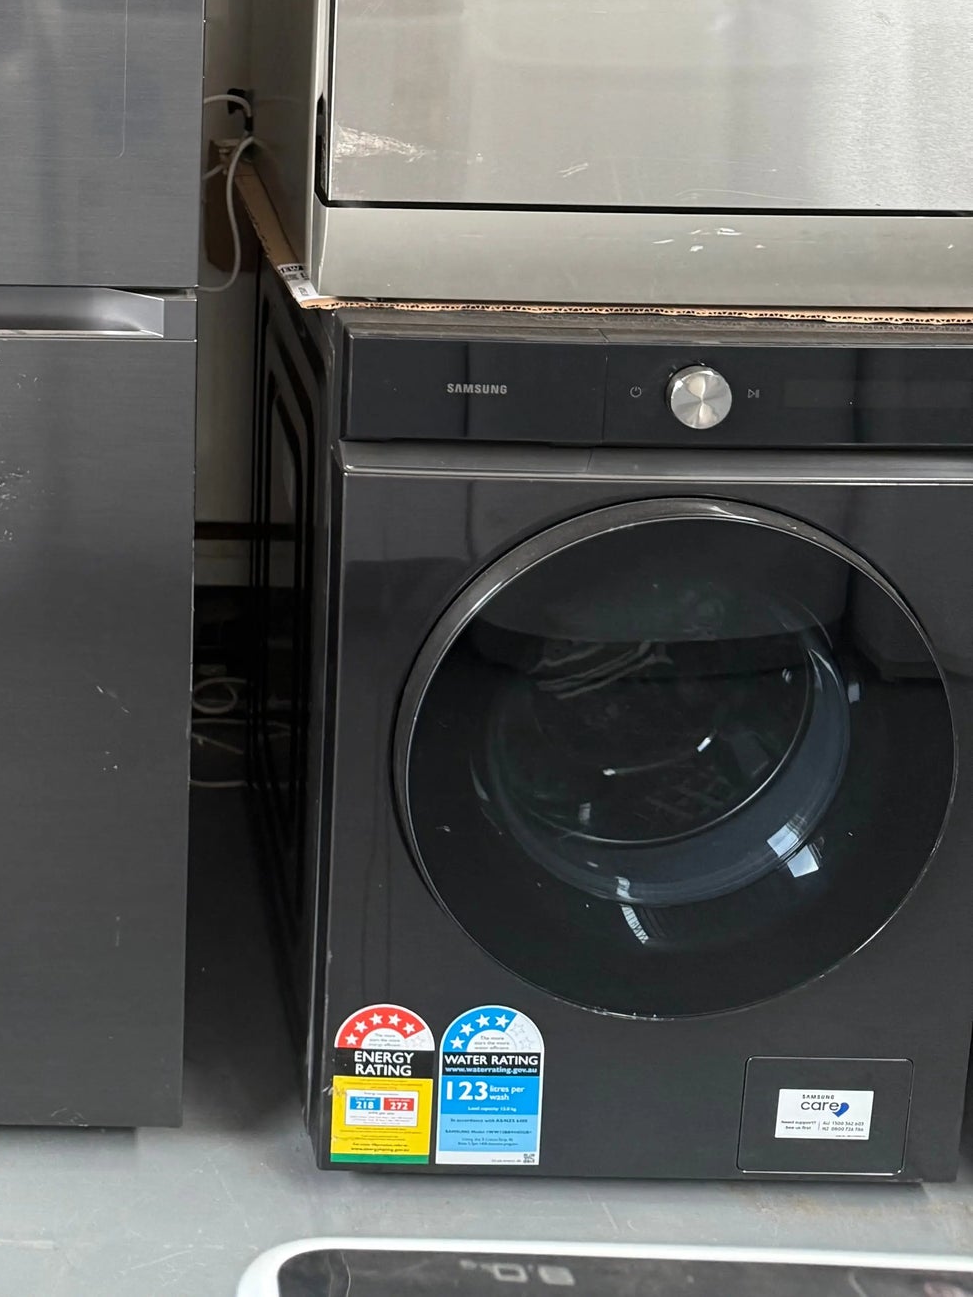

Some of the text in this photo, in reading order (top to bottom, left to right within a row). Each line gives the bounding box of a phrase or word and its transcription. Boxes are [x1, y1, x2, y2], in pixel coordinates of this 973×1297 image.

[446, 383, 508, 395] SAMSUNG
[354, 1050, 414, 1064] ENERGY
[444, 1055, 539, 1066] WATER RATING
[355, 1063, 412, 1076] RATING
[445, 1066, 538, 1074] www.waterrating.gov.au
[446, 1081, 525, 1100] 123 litres per
[489, 1093, 509, 1101] wash
[356, 1101, 409, 1110] 218 272
[800, 1101, 840, 1111] care
